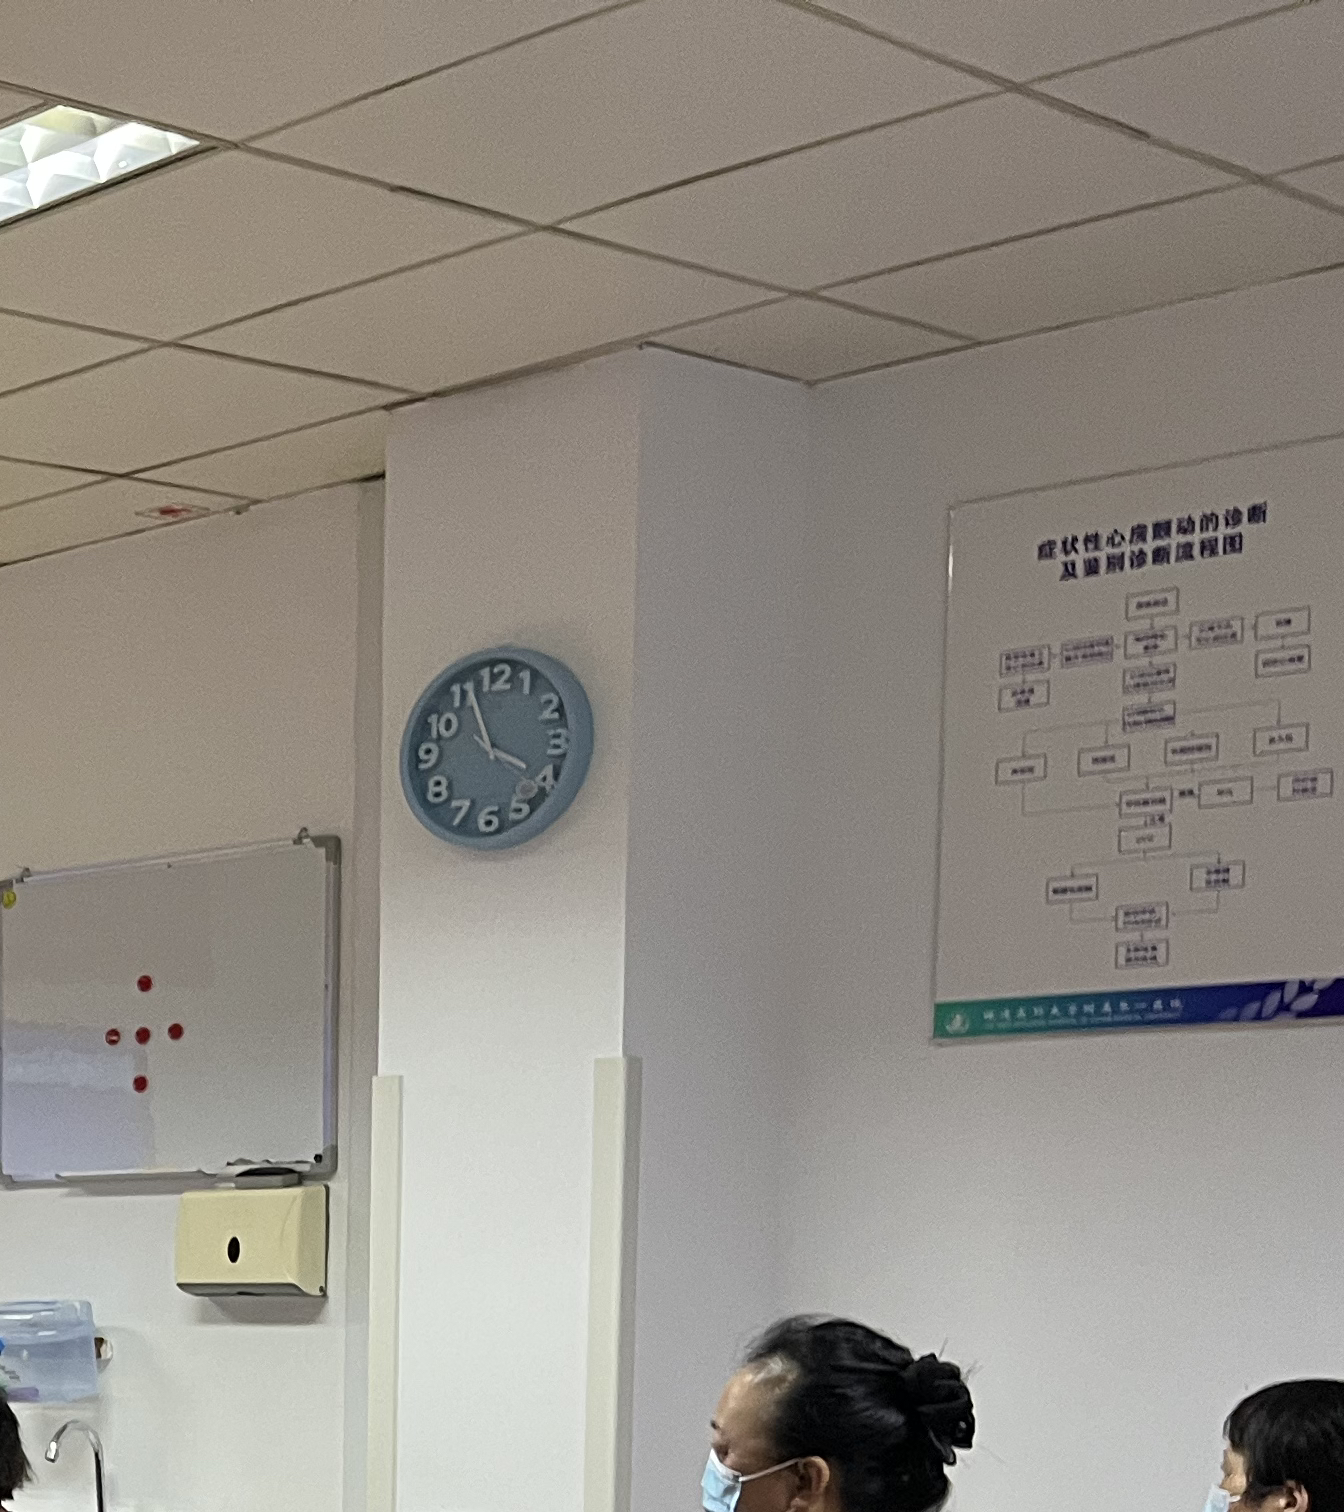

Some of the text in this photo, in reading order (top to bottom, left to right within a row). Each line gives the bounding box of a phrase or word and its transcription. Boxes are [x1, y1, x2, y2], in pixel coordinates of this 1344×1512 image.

[480, 662, 511, 692] 12
[519, 669, 530, 695] 1
[450, 680, 475, 708] 11
[538, 692, 560, 720] 2
[427, 712, 458, 738] 10
[418, 742, 439, 770] 9
[546, 728, 568, 756] 3
[427, 775, 448, 803] 8
[535, 764, 555, 792] 4
[451, 799, 470, 825] 7
[477, 805, 499, 832] 6
